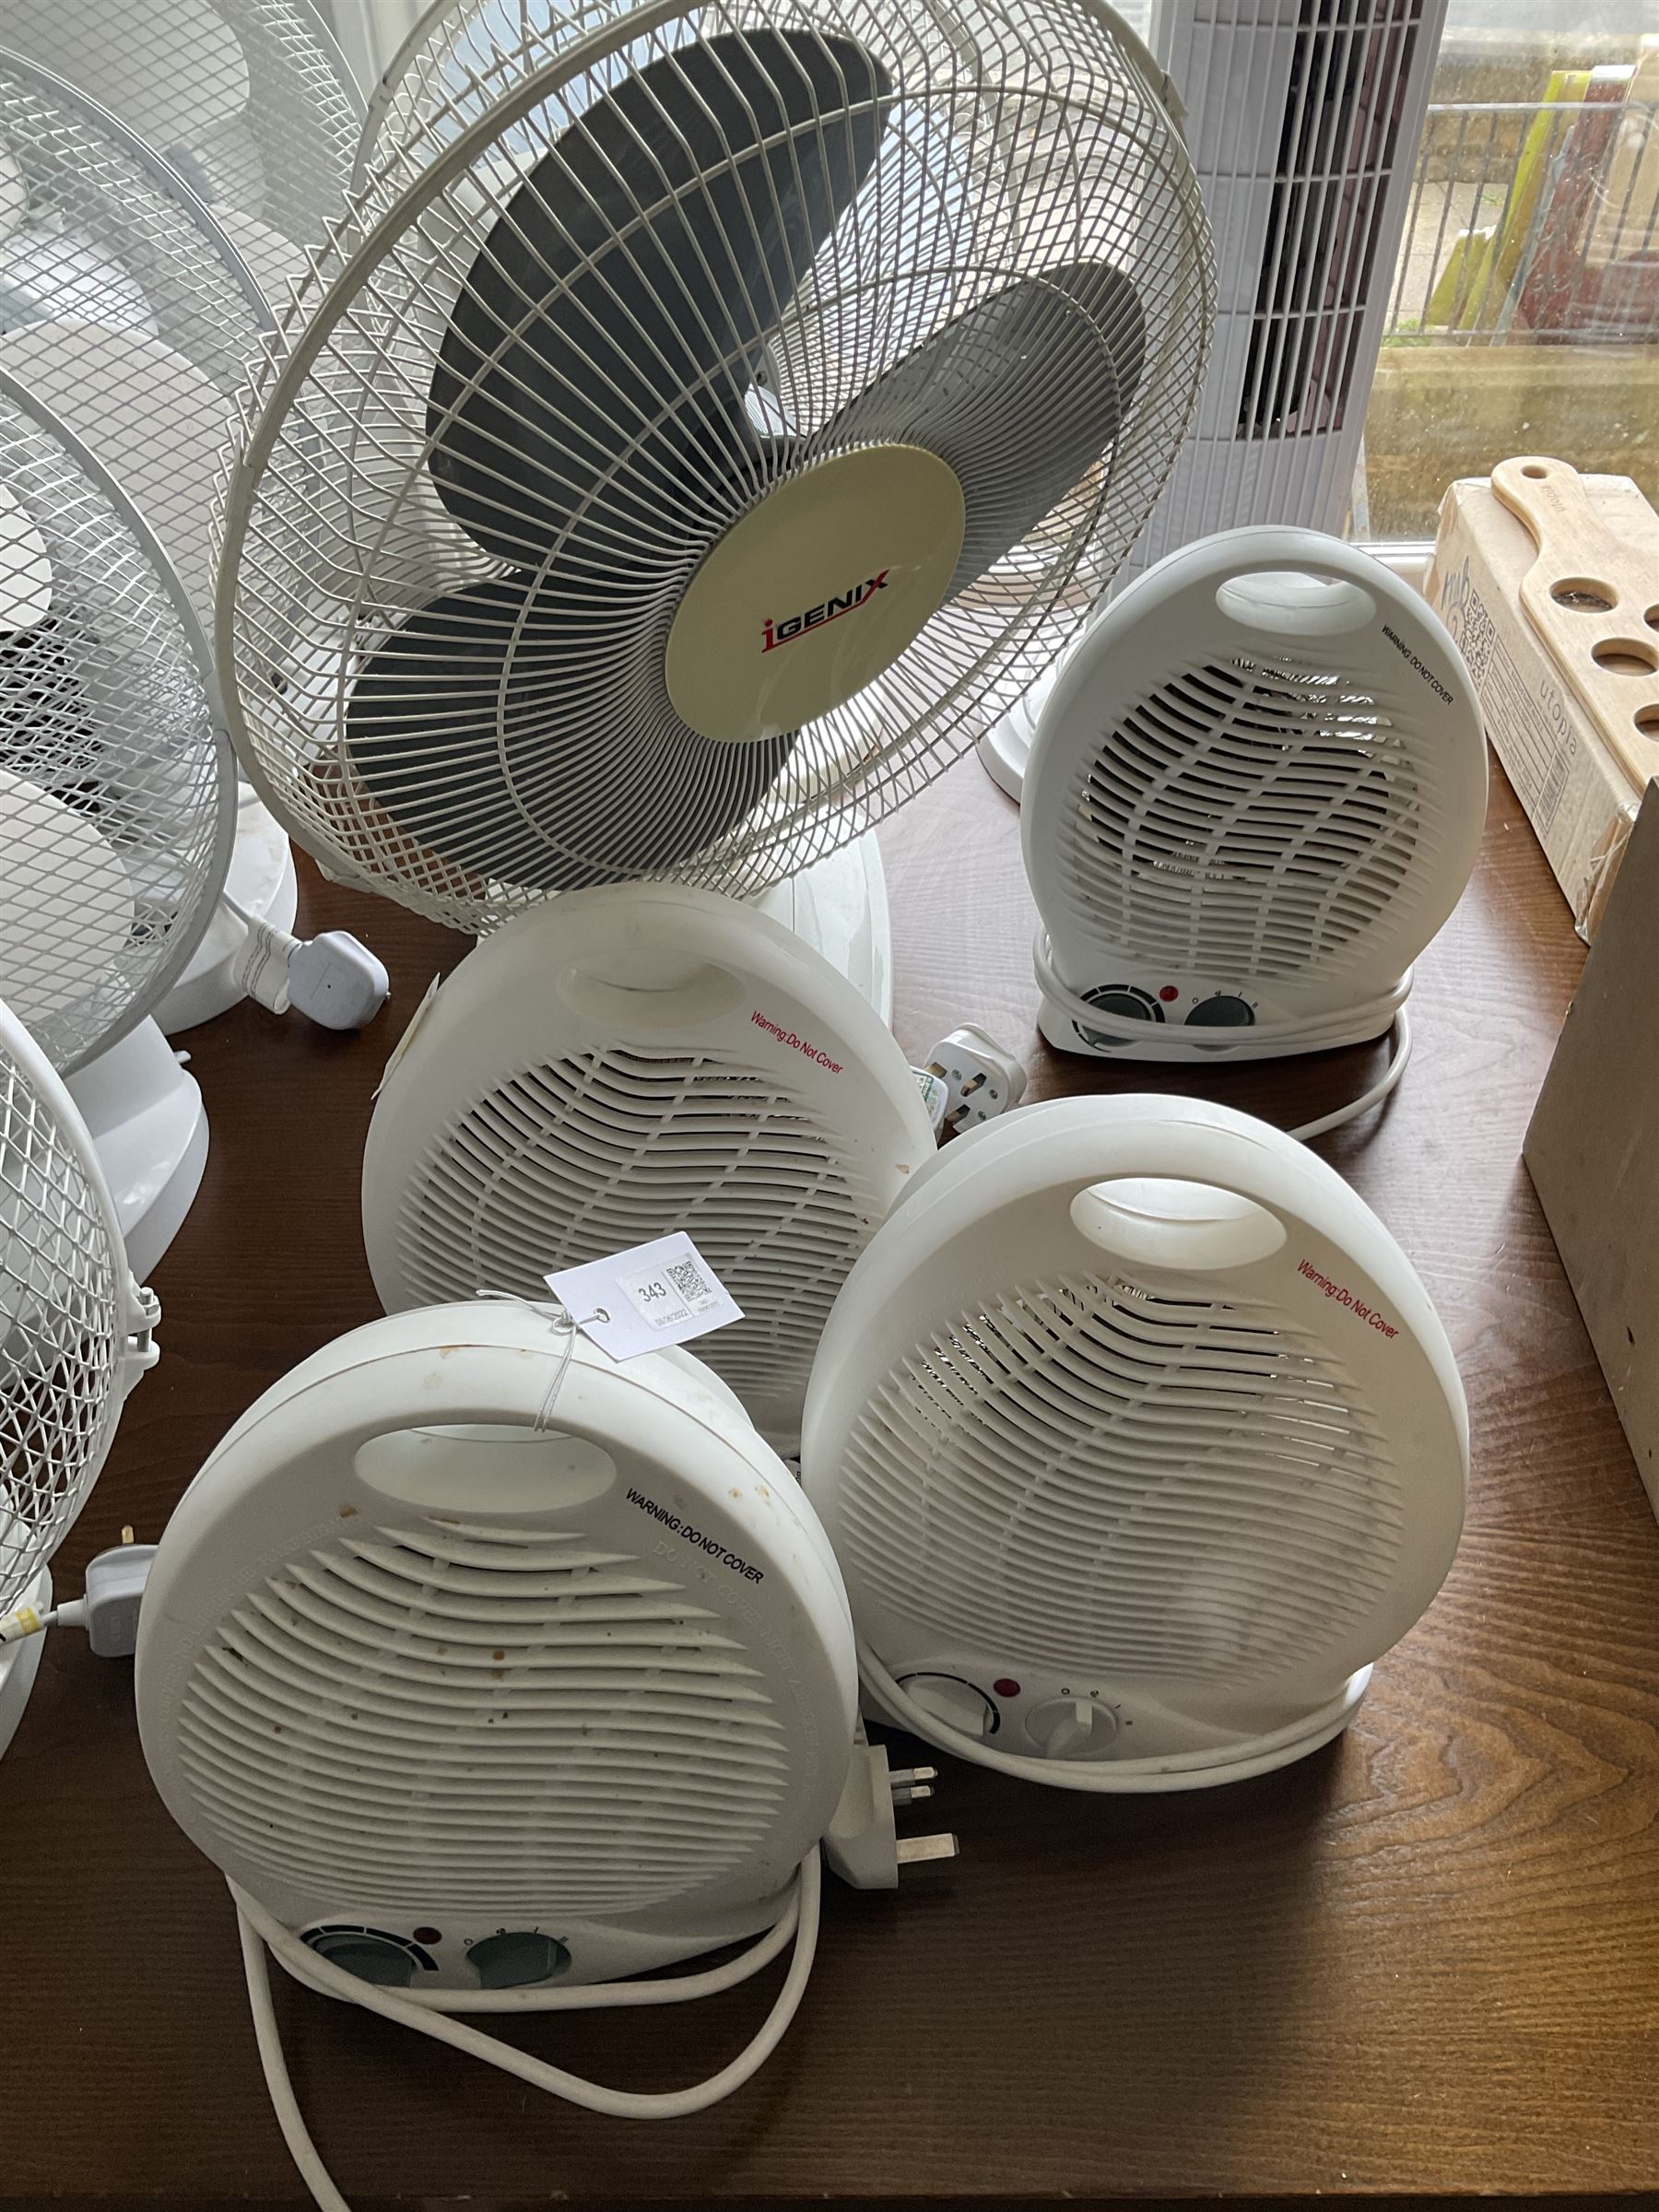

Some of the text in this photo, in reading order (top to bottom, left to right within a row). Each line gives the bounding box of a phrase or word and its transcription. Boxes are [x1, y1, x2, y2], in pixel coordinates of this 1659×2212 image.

[1410, 656, 1422, 670] DO
[1418, 666, 1435, 683] NOT
[1430, 680, 1453, 705] COVER
[799, 1041, 818, 1059] Not
[817, 1052, 843, 1074] Cover
[638, 1282, 666, 1302] 343
[1350, 1300, 1371, 1320] Not
[1369, 1312, 1399, 1339] Cover
[681, 1525, 701, 1544] DO
[699, 1537, 726, 1559] NOT
[723, 1554, 764, 1583] COVER
